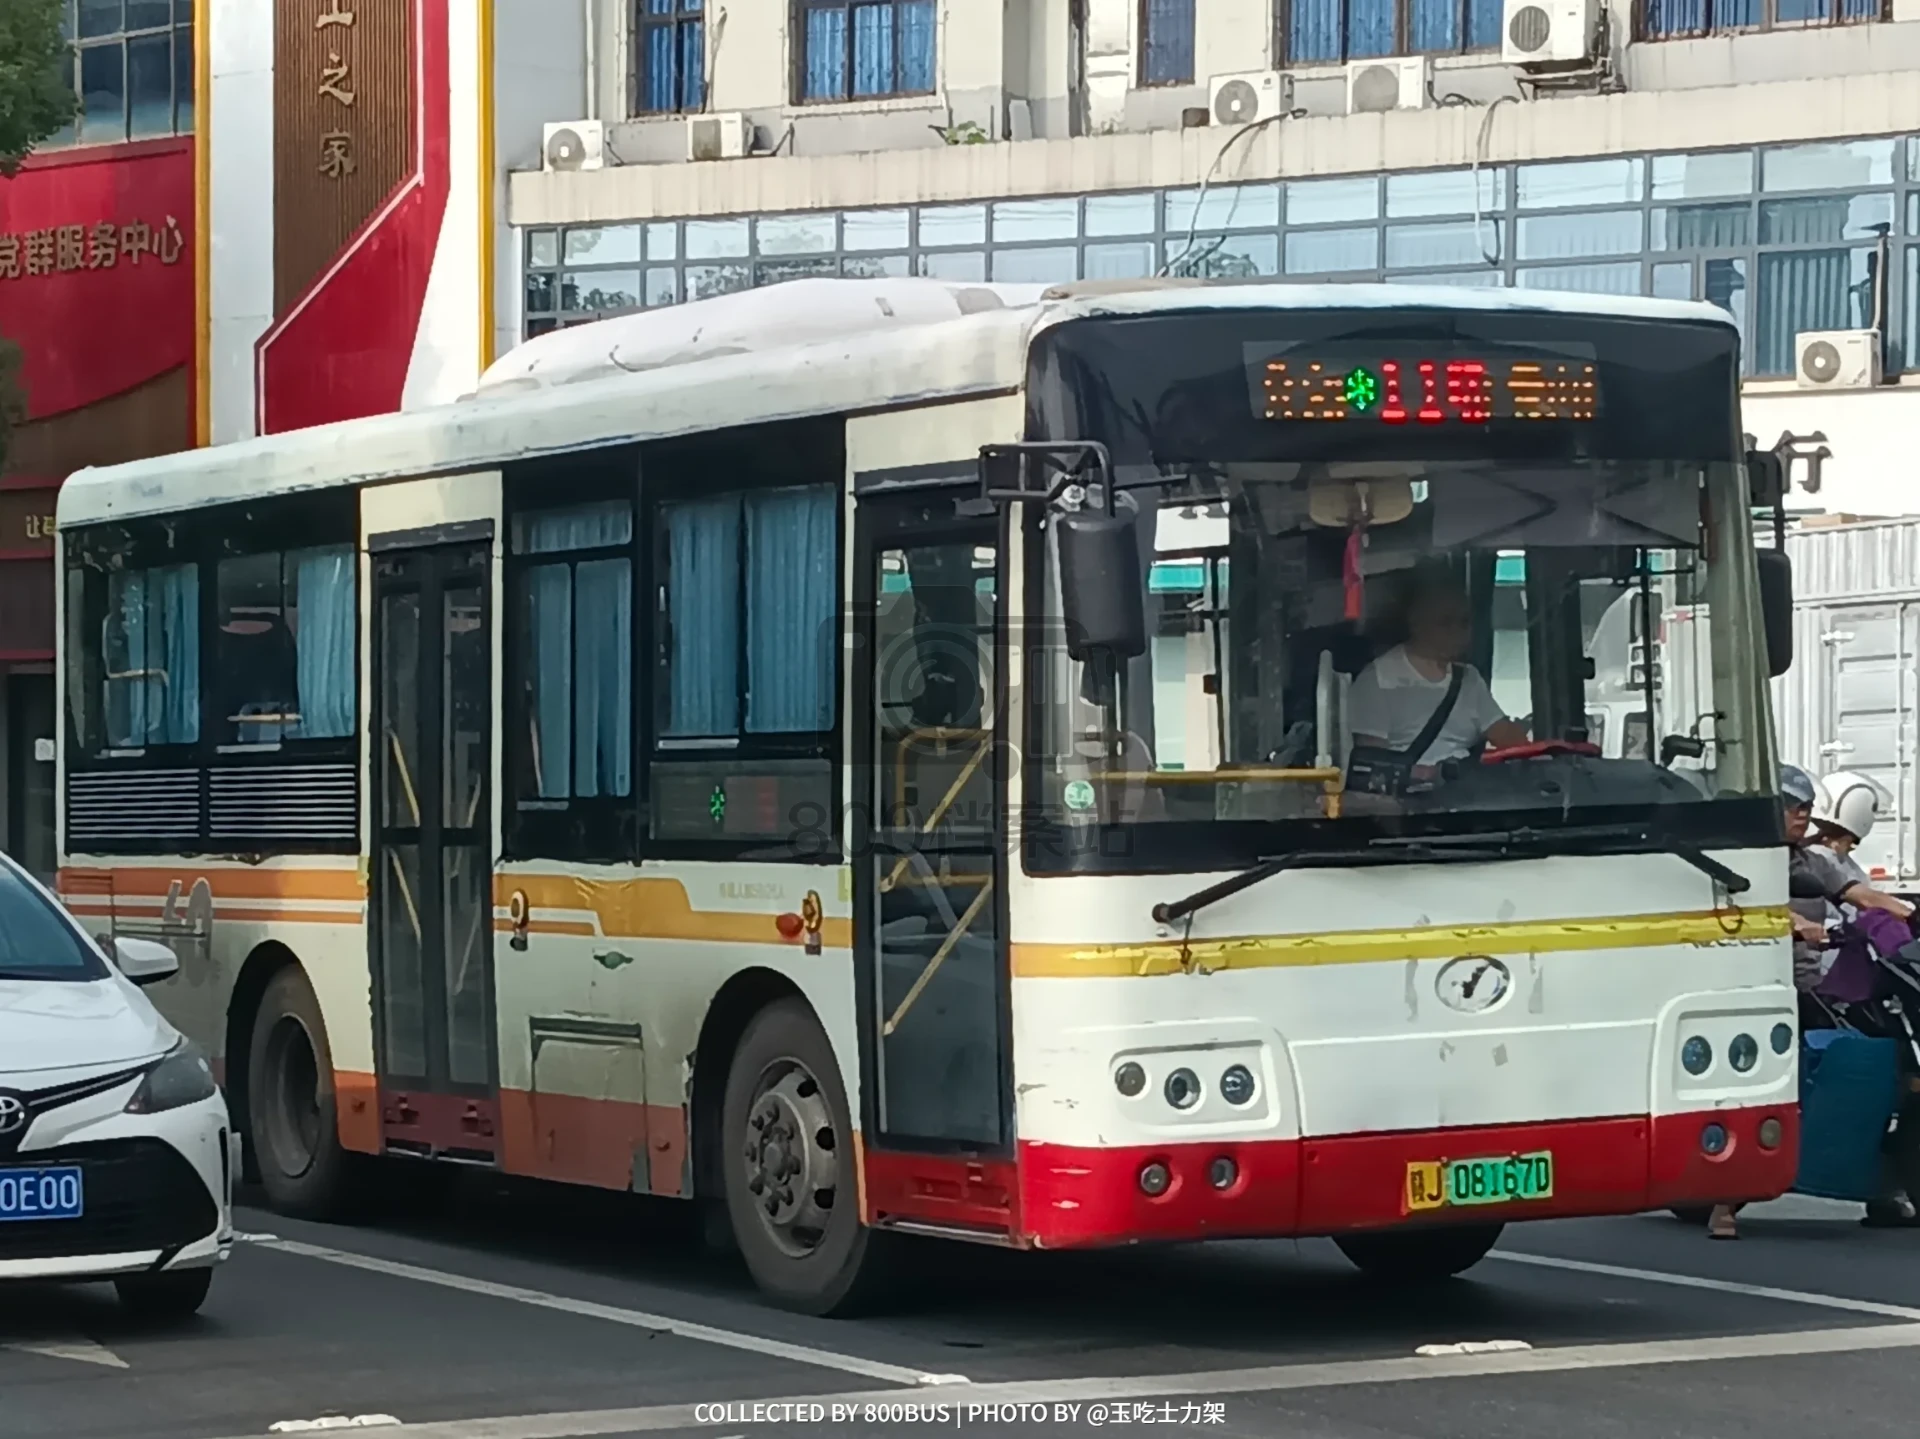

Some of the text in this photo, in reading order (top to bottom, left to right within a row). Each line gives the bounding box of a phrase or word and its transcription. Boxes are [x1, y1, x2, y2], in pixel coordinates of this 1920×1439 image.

[0, 214, 183, 278] 党群服务中心
